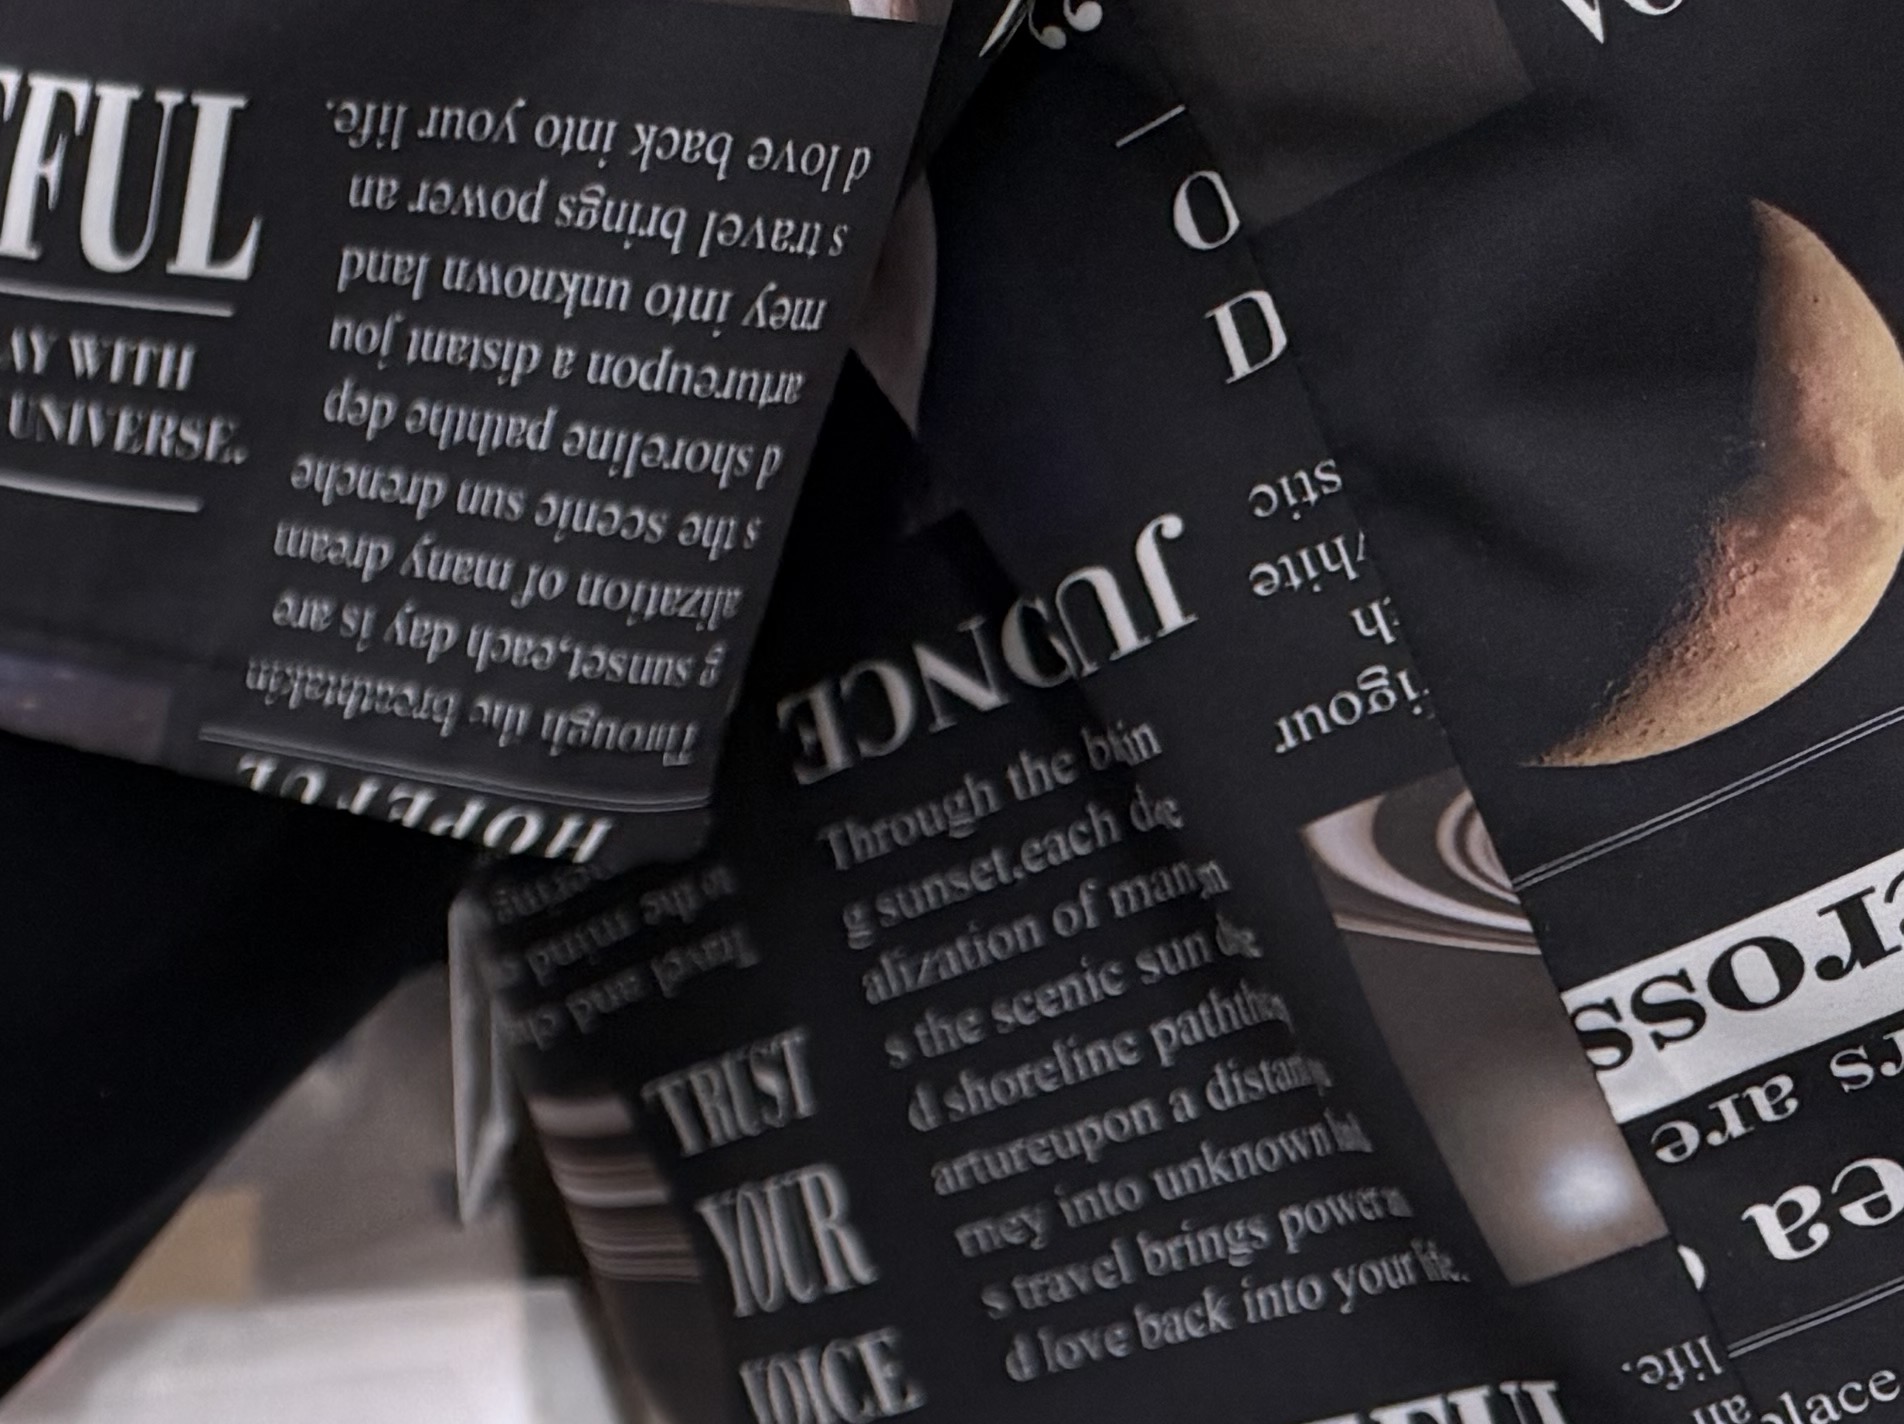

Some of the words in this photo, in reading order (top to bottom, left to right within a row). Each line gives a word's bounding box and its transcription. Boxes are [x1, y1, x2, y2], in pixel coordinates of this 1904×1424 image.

[325, 99, 409, 151] life.
[417, 97, 528, 145] your
[534, 112, 618, 170] into
[632, 121, 735, 182] back
[347, 173, 401, 210] an
[747, 134, 839, 195] love
[842, 143, 874, 195] d
[406, 176, 550, 225] power
[555, 182, 689, 256] brings
[697, 209, 827, 260] travel
[826, 221, 850, 259] s
[336, 245, 432, 302] land
[441, 254, 632, 320] unknown
[328, 311, 406, 371] jou
[644, 281, 735, 339] into
[69, 328, 195, 392] WITH
[407, 327, 543, 389] distant
[551, 347, 577, 378] a
[586, 347, 807, 406] artureupon
[9, 387, 250, 466] UNIVERSE.
[323, 376, 396, 442] dep
[405, 405, 559, 458] paththe
[562, 420, 755, 482] shoreline
[756, 443, 786, 491] d
[290, 453, 448, 522] drenche
[455, 479, 527, 523] sun
[533, 486, 668, 544] scenic
[1247, 456, 1346, 522] stic
[272, 518, 395, 583] dream
[400, 530, 517, 595] many
[678, 510, 743, 563] the
[743, 515, 766, 551] s
[1248, 528, 1368, 599] hite
[271, 588, 338, 635] are
[510, 562, 569, 611] of
[574, 570, 743, 632] alization
[339, 595, 378, 653] is
[386, 601, 460, 664] day
[1349, 595, 1401, 648] h
[245, 656, 459, 738] breathtakin
[467, 696, 531, 749] the
[1274, 661, 1434, 757] igour
[540, 703, 701, 768] Through
[816, 773, 1002, 871] Through
[1006, 750, 1078, 801] the
[843, 902, 876, 951] g
[862, 913, 1046, 1005] alization
[1052, 877, 1102, 939] of
[885, 1034, 913, 1069] s
[914, 1004, 989, 1059] the
[992, 953, 1129, 1034] scenic
[1136, 931, 1214, 985] sun
[1571, 868, 1904, 1072] ross
[640, 1023, 819, 1158] TRUST
[908, 1081, 942, 1132] d
[943, 1028, 1145, 1122] shoreline
[930, 1097, 1164, 1197] artureupon
[1169, 1087, 1201, 1125] a
[1650, 1073, 1799, 1164] are
[1054, 1176, 1145, 1229] into
[1151, 1121, 1331, 1201] unknown
[693, 1163, 881, 1318] YOUR
[981, 1283, 1013, 1320] s
[1012, 1236, 1137, 1312] travel
[1137, 1214, 1270, 1278] brings
[1004, 1331, 1036, 1383] d
[1036, 1318, 1134, 1374] love
[1134, 1285, 1237, 1351] back
[1240, 1269, 1325, 1324] into
[1331, 1250, 1417, 1315] your
[1621, 1335, 1724, 1392] life.
